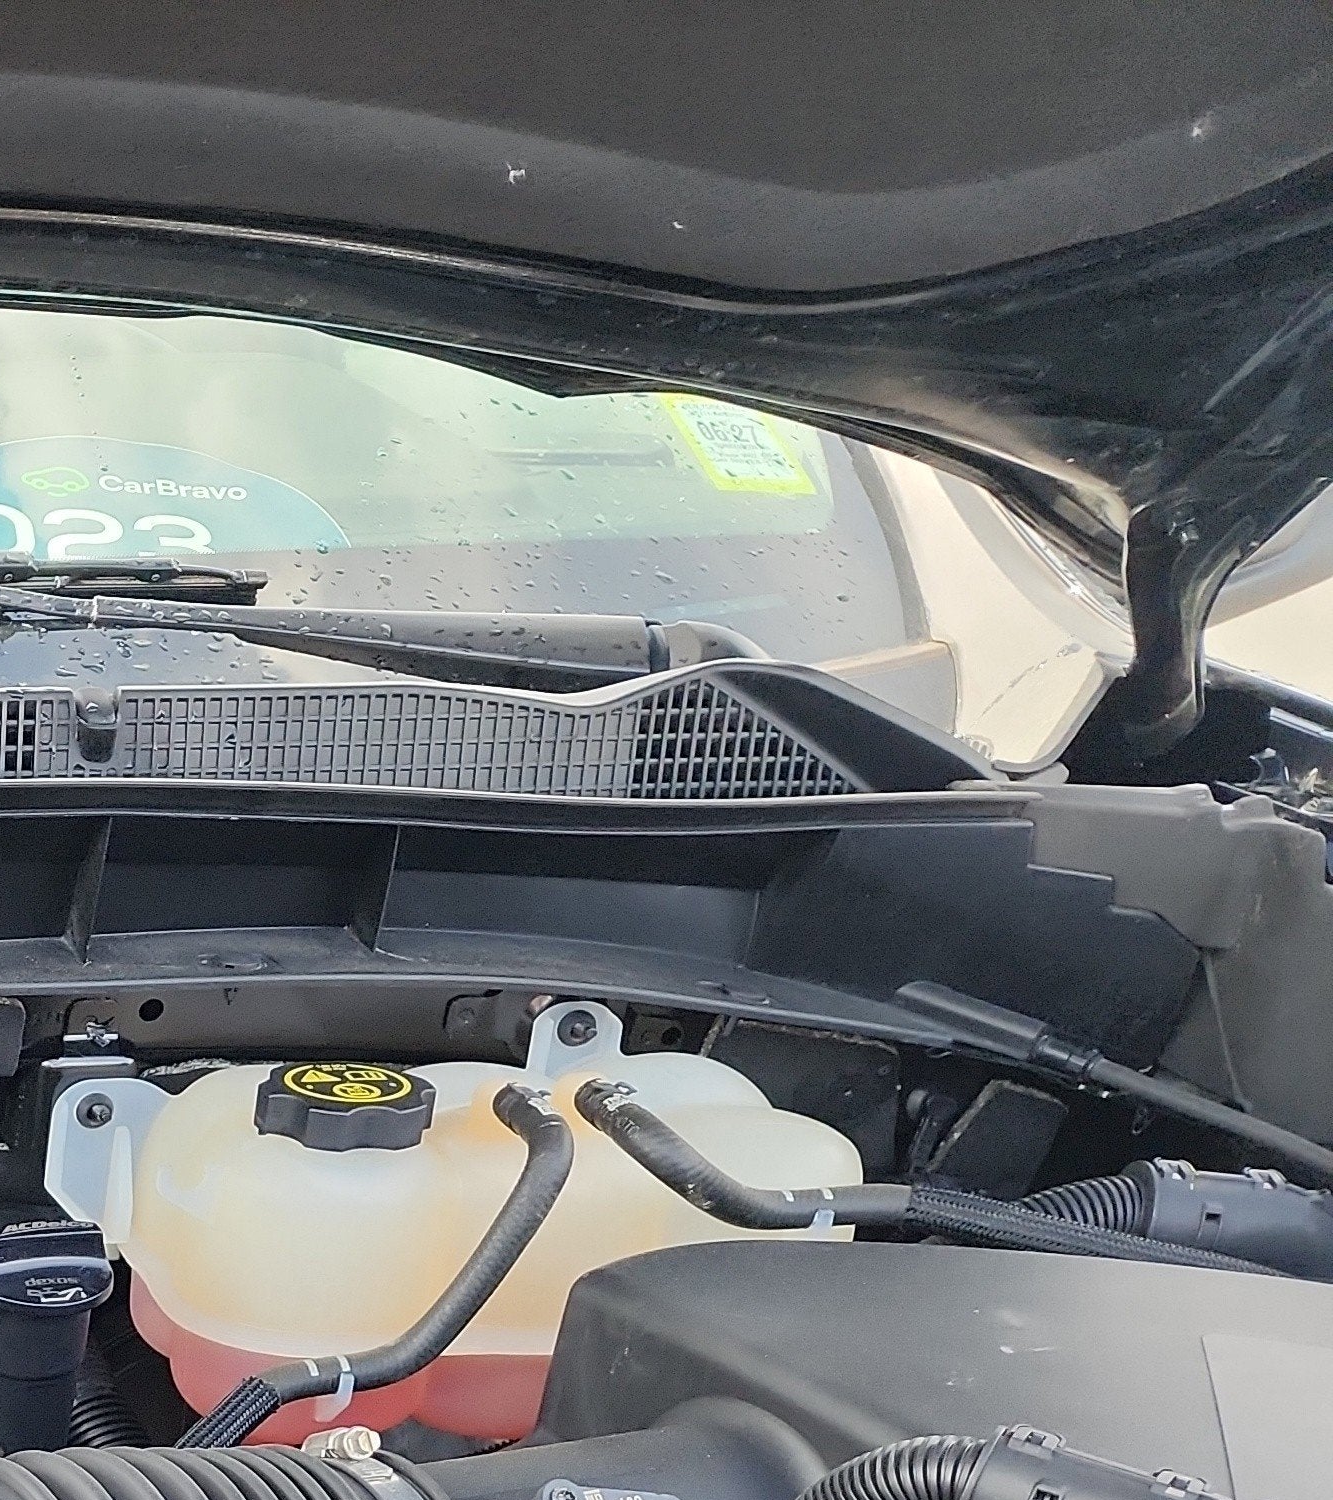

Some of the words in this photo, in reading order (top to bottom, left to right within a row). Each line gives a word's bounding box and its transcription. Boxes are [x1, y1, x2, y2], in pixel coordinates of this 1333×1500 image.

[98, 473, 248, 502] CarBravo
[2, 1219, 96, 1234] ACDelco
[24, 1276, 80, 1288] dexos
